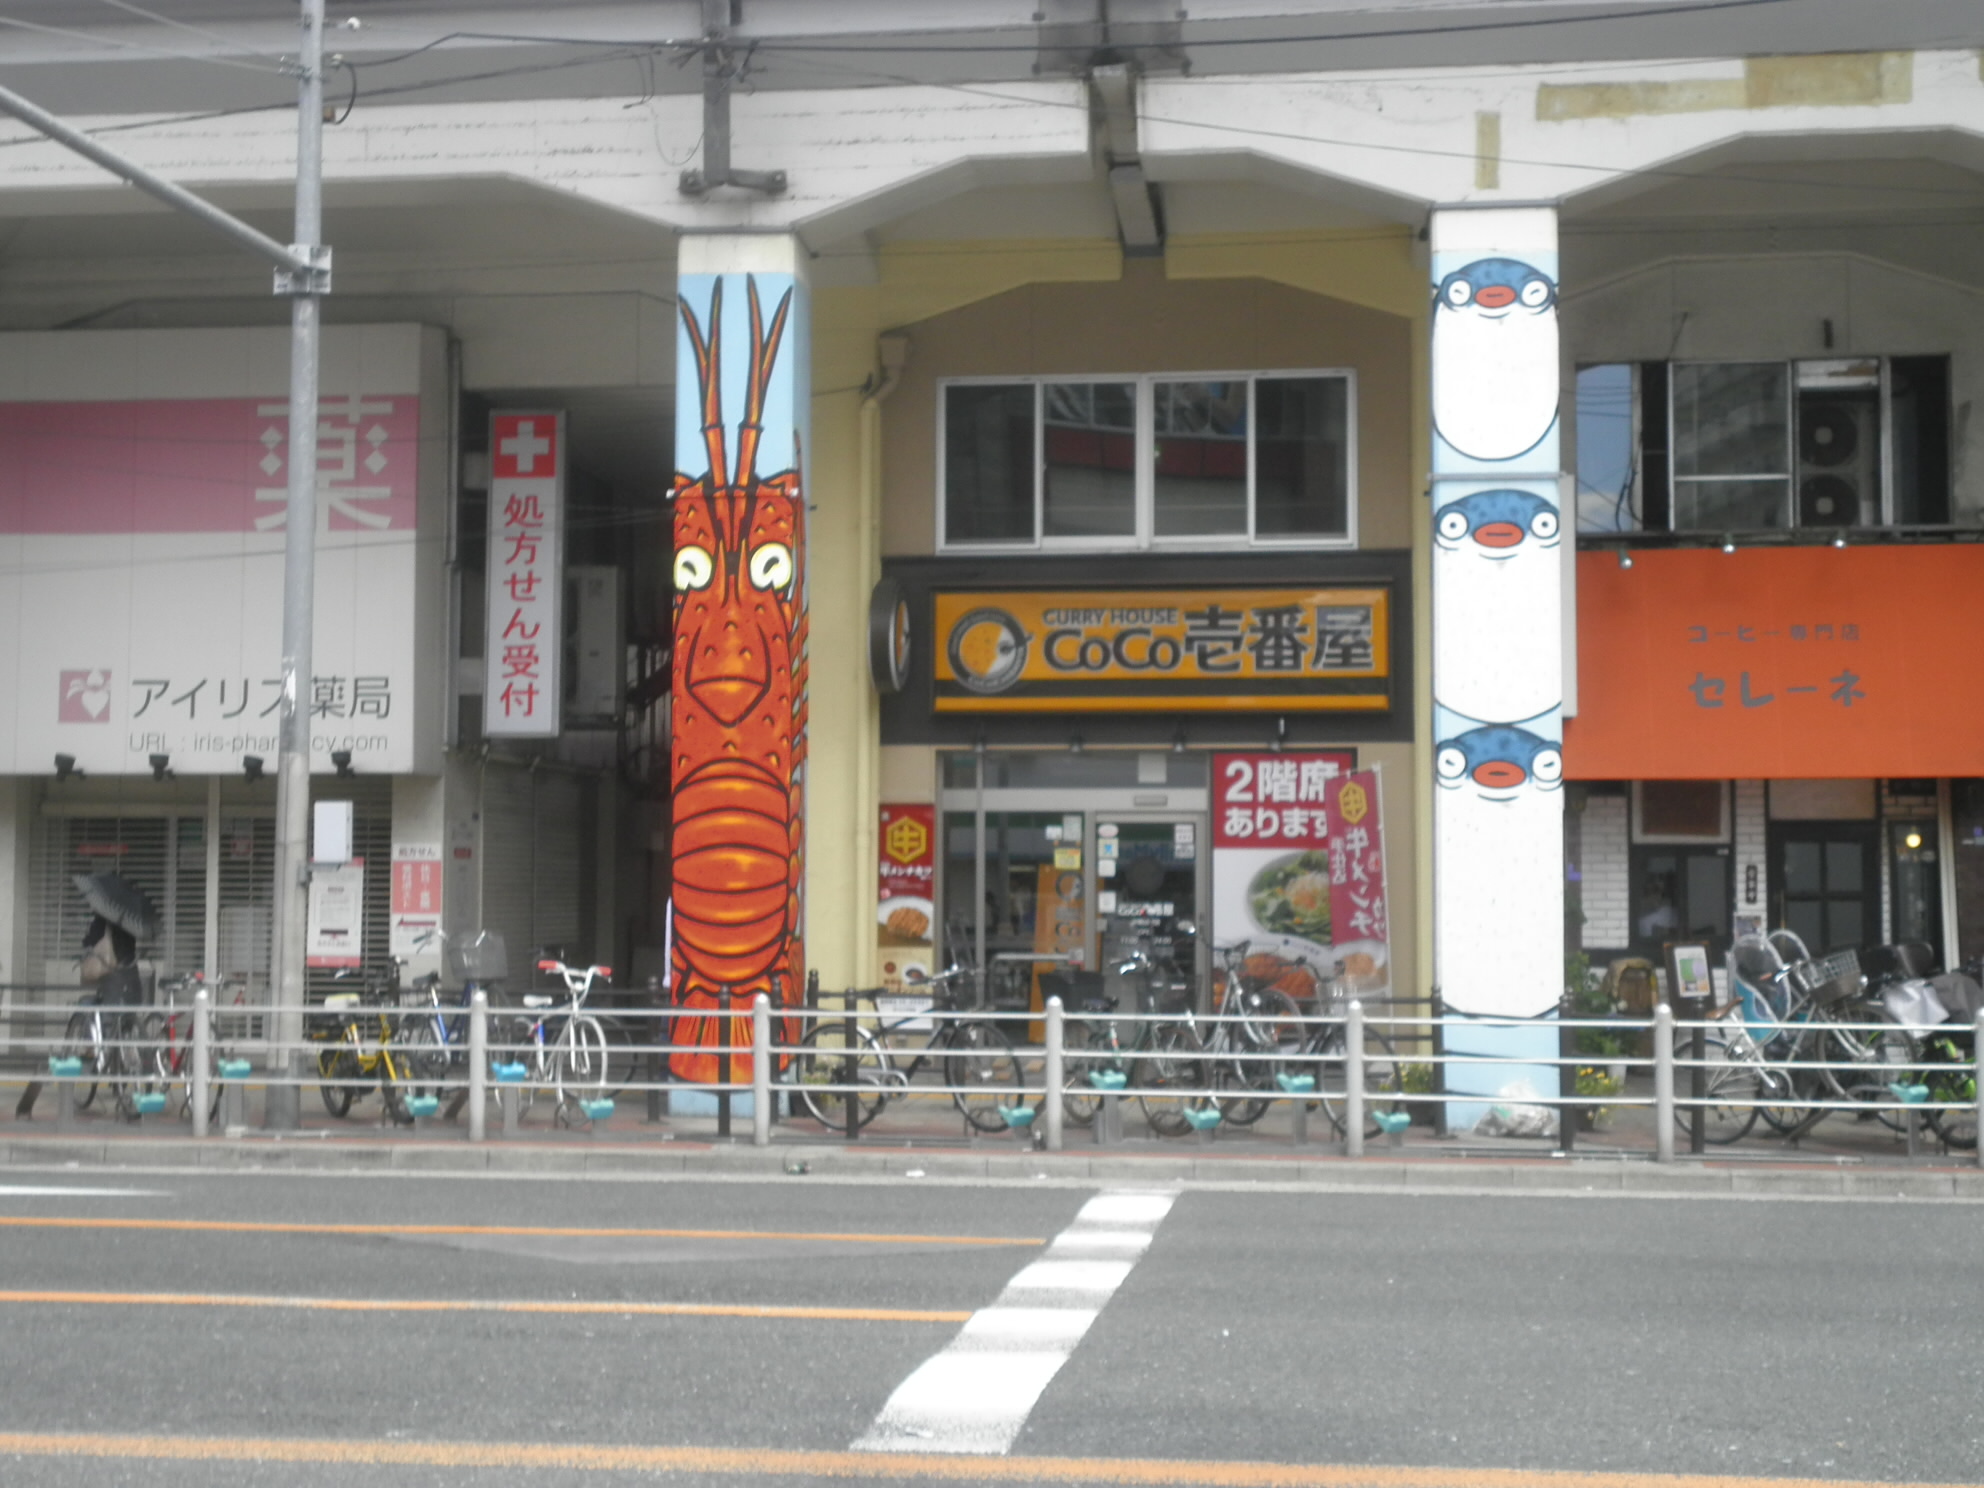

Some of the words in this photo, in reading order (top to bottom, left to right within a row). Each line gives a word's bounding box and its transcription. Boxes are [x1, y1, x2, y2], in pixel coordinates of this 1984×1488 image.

[254, 394, 393, 532] 薬
[501, 494, 544, 717] 処方せん受付
[1043, 608, 1106, 626] CURRY
[1110, 607, 1178, 626] HOUSE
[1043, 604, 1375, 673] CoCo壱番屋
[1687, 624, 1861, 642] コーヒー専門店
[132, 676, 391, 719] アイリス薬局
[1688, 670, 1866, 708] セレーネ
[193, 732, 389, 753] iris-pharcy.com
[1225, 760, 1339, 803] 2階席
[1224, 807, 1328, 838] あります
